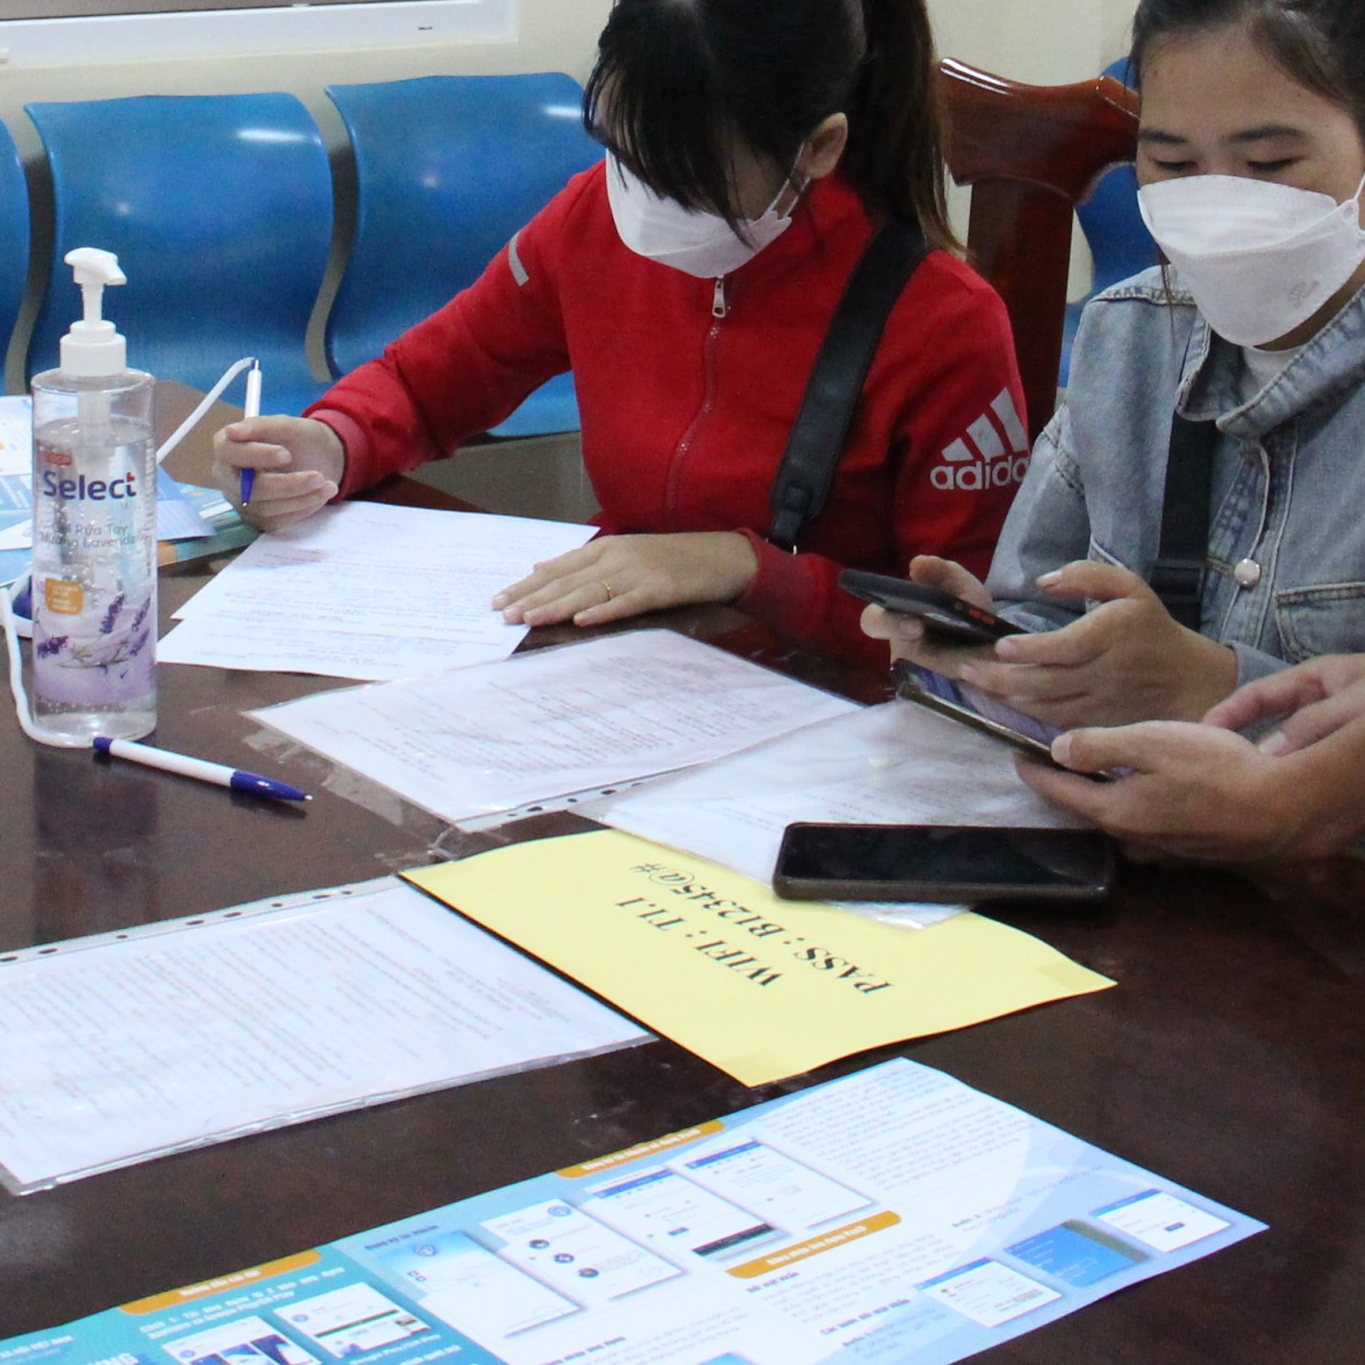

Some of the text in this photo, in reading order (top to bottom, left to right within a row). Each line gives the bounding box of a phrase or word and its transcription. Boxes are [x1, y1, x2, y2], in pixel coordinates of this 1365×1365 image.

[43, 470, 137, 501] Select
[930, 455, 1030, 491] adida
[615, 897, 685, 932] T1.1
[630, 863, 786, 938] B12345@#
[695, 940, 783, 987] WIFI
[793, 946, 893, 994] PASS
